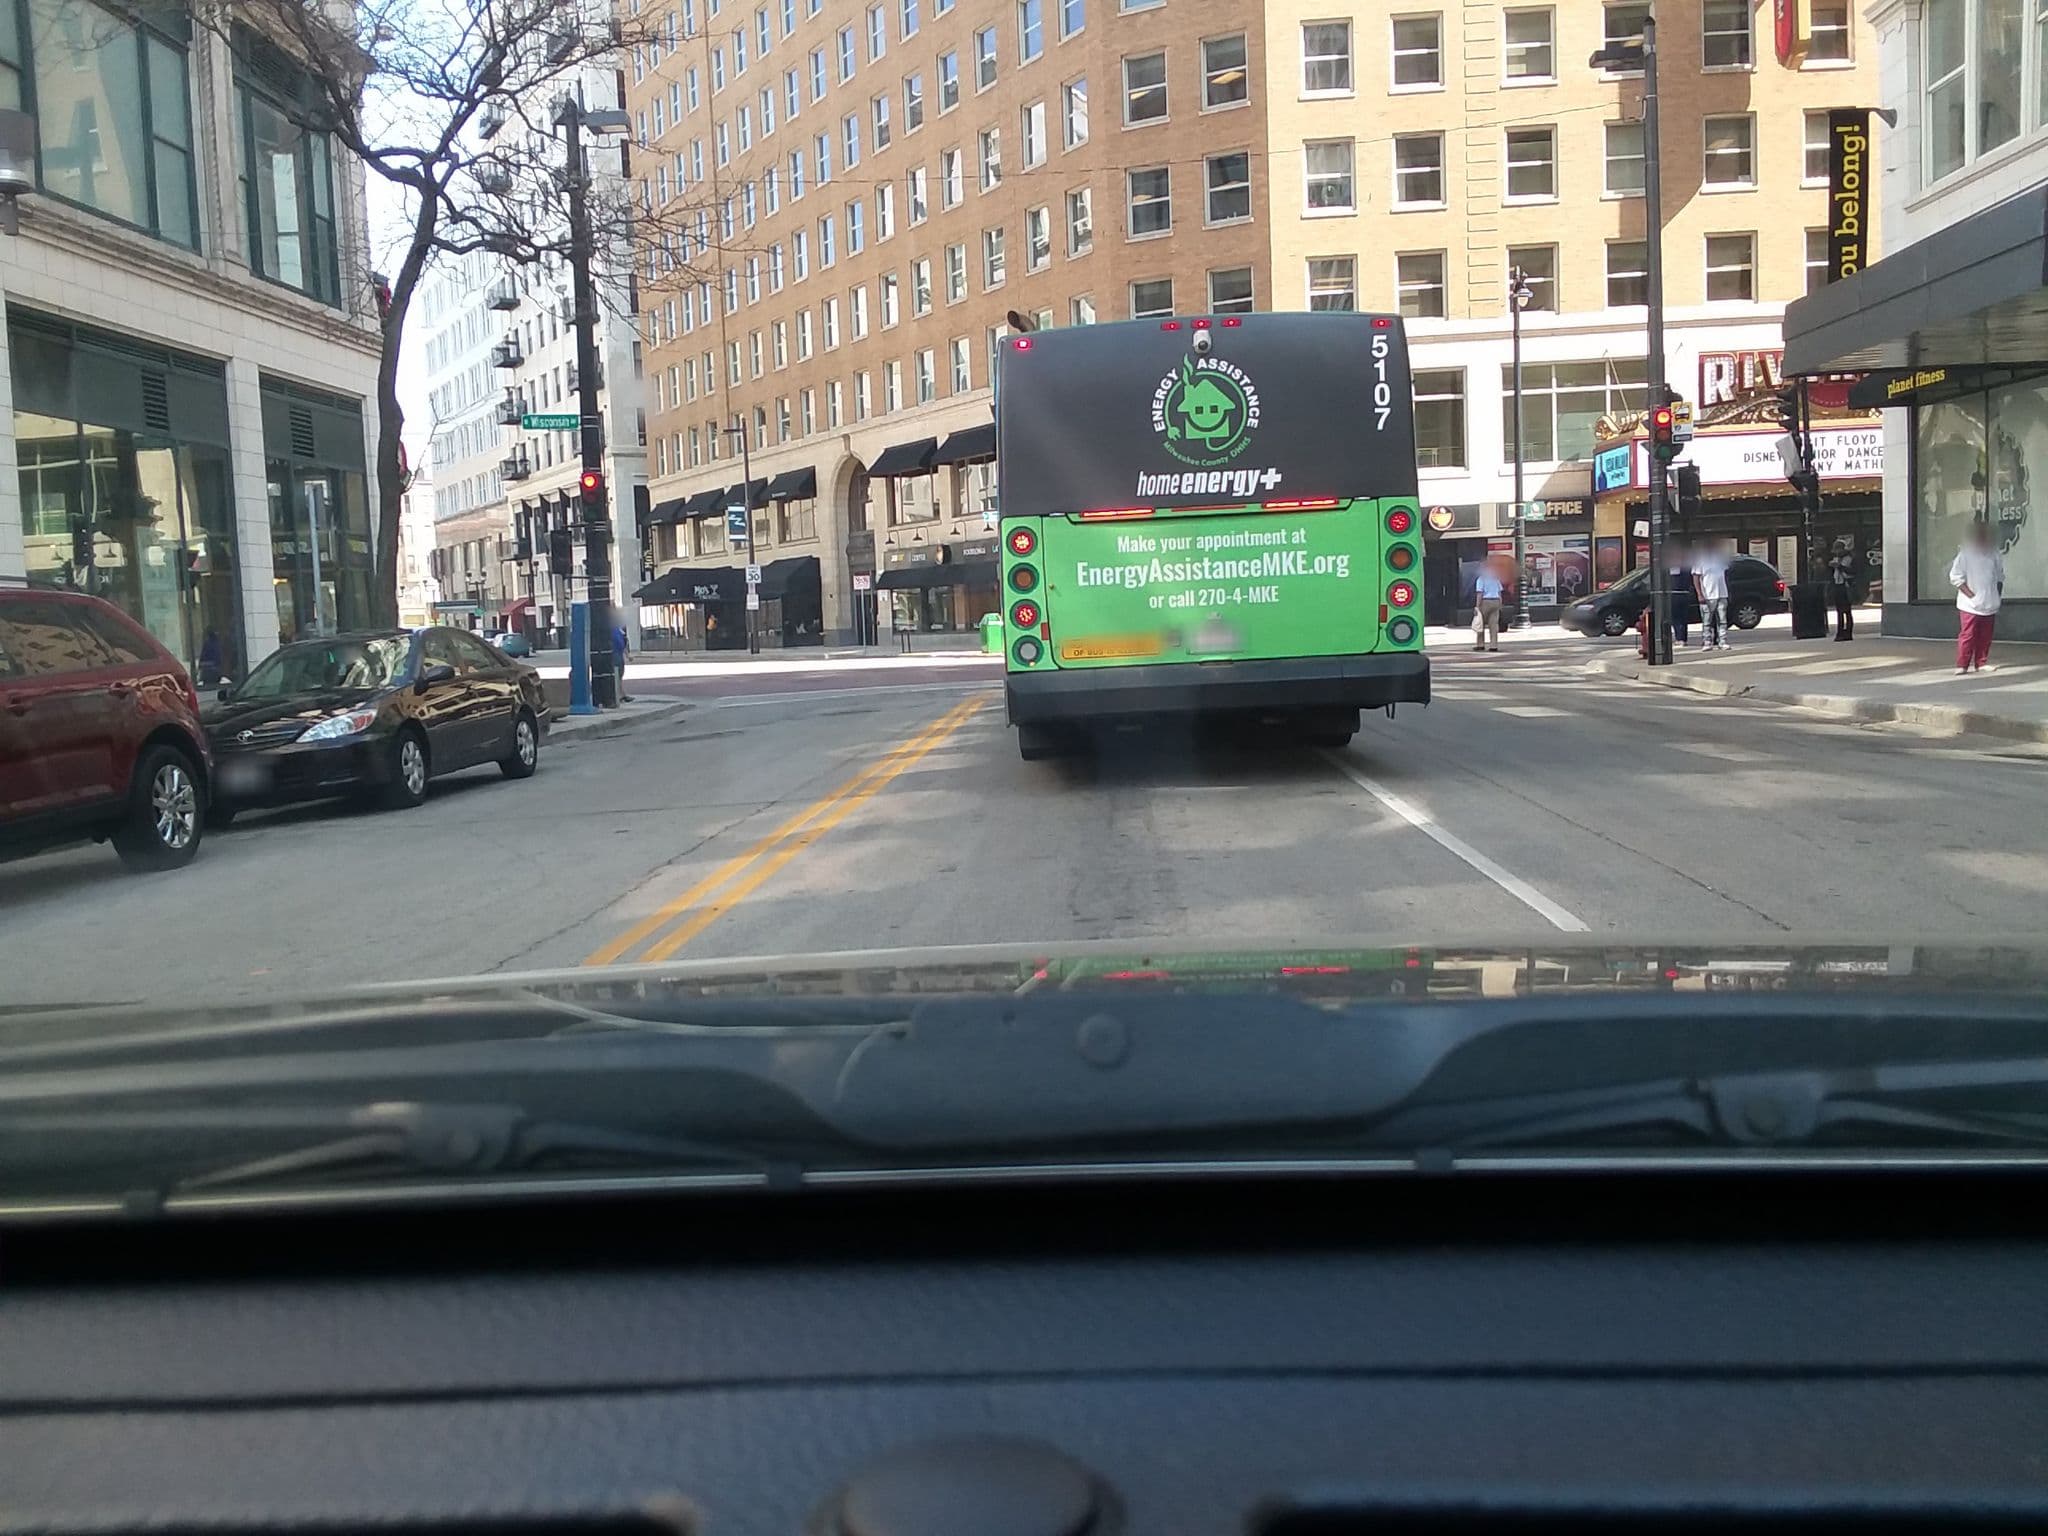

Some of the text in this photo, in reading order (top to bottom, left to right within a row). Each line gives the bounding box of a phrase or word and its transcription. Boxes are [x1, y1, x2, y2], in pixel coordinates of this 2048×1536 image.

[1835, 125, 1866, 279] ou belong!
[1371, 334, 1391, 431] 5107
[1700, 351, 1784, 408] RIV
[1887, 369, 1946, 399] planet fitness
[1152, 358, 1260, 432] ENERGY ASSISTANCE
[1837, 434, 1877, 446] FLOYD
[1848, 446, 1884, 458] DANCE
[1201, 456, 1229, 466] County
[1845, 459, 1884, 470] MATHI
[1546, 500, 1583, 516] FFICE
[1117, 528, 1307, 553] Make your appointment at
[1077, 550, 1350, 589] EnergyAssistanceMKE.org
[1149, 586, 1280, 608] or call 270-4-MKE
